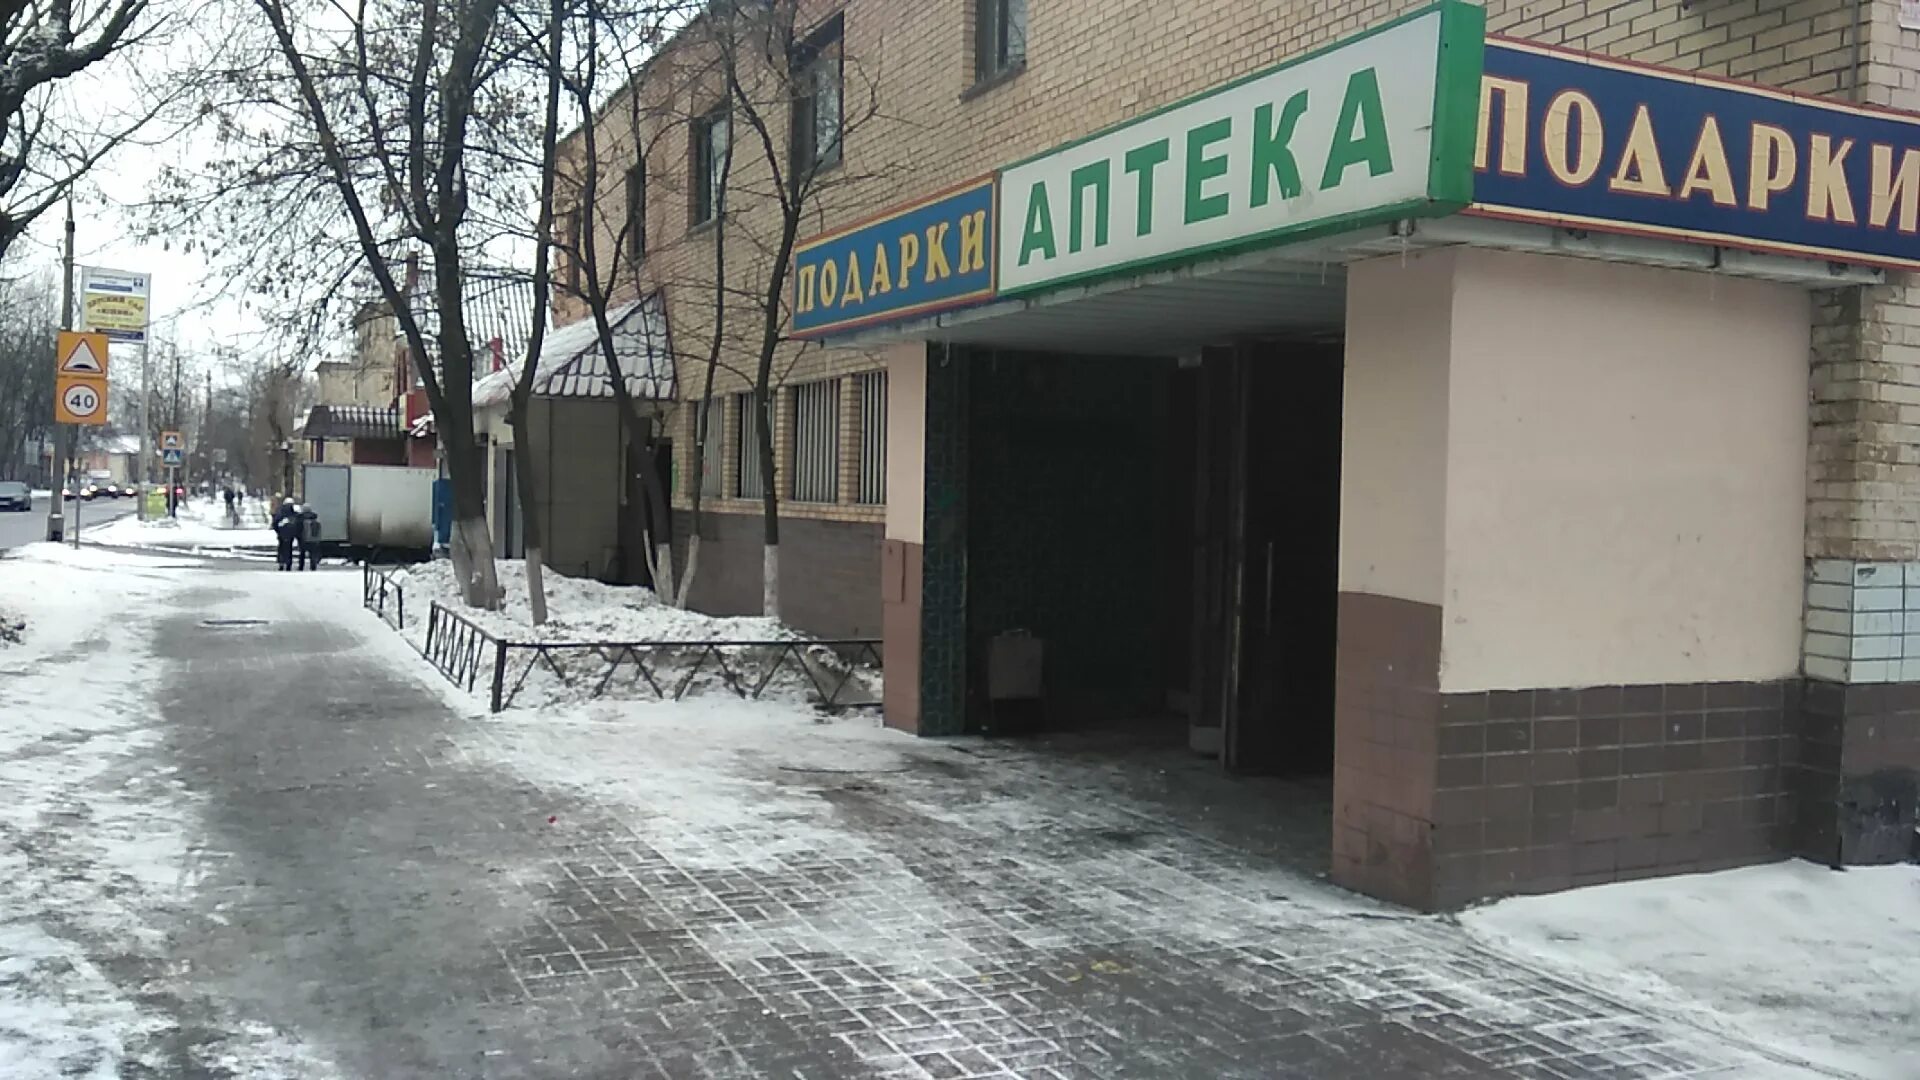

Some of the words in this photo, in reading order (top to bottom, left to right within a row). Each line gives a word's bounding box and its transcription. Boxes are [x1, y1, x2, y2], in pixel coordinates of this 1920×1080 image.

[1018, 66, 1394, 267] АПТЕКА
[1474, 75, 1920, 233] ПОДАРКИ
[796, 209, 986, 314] ПОДАРКИ
[70, 394, 95, 409] 40
